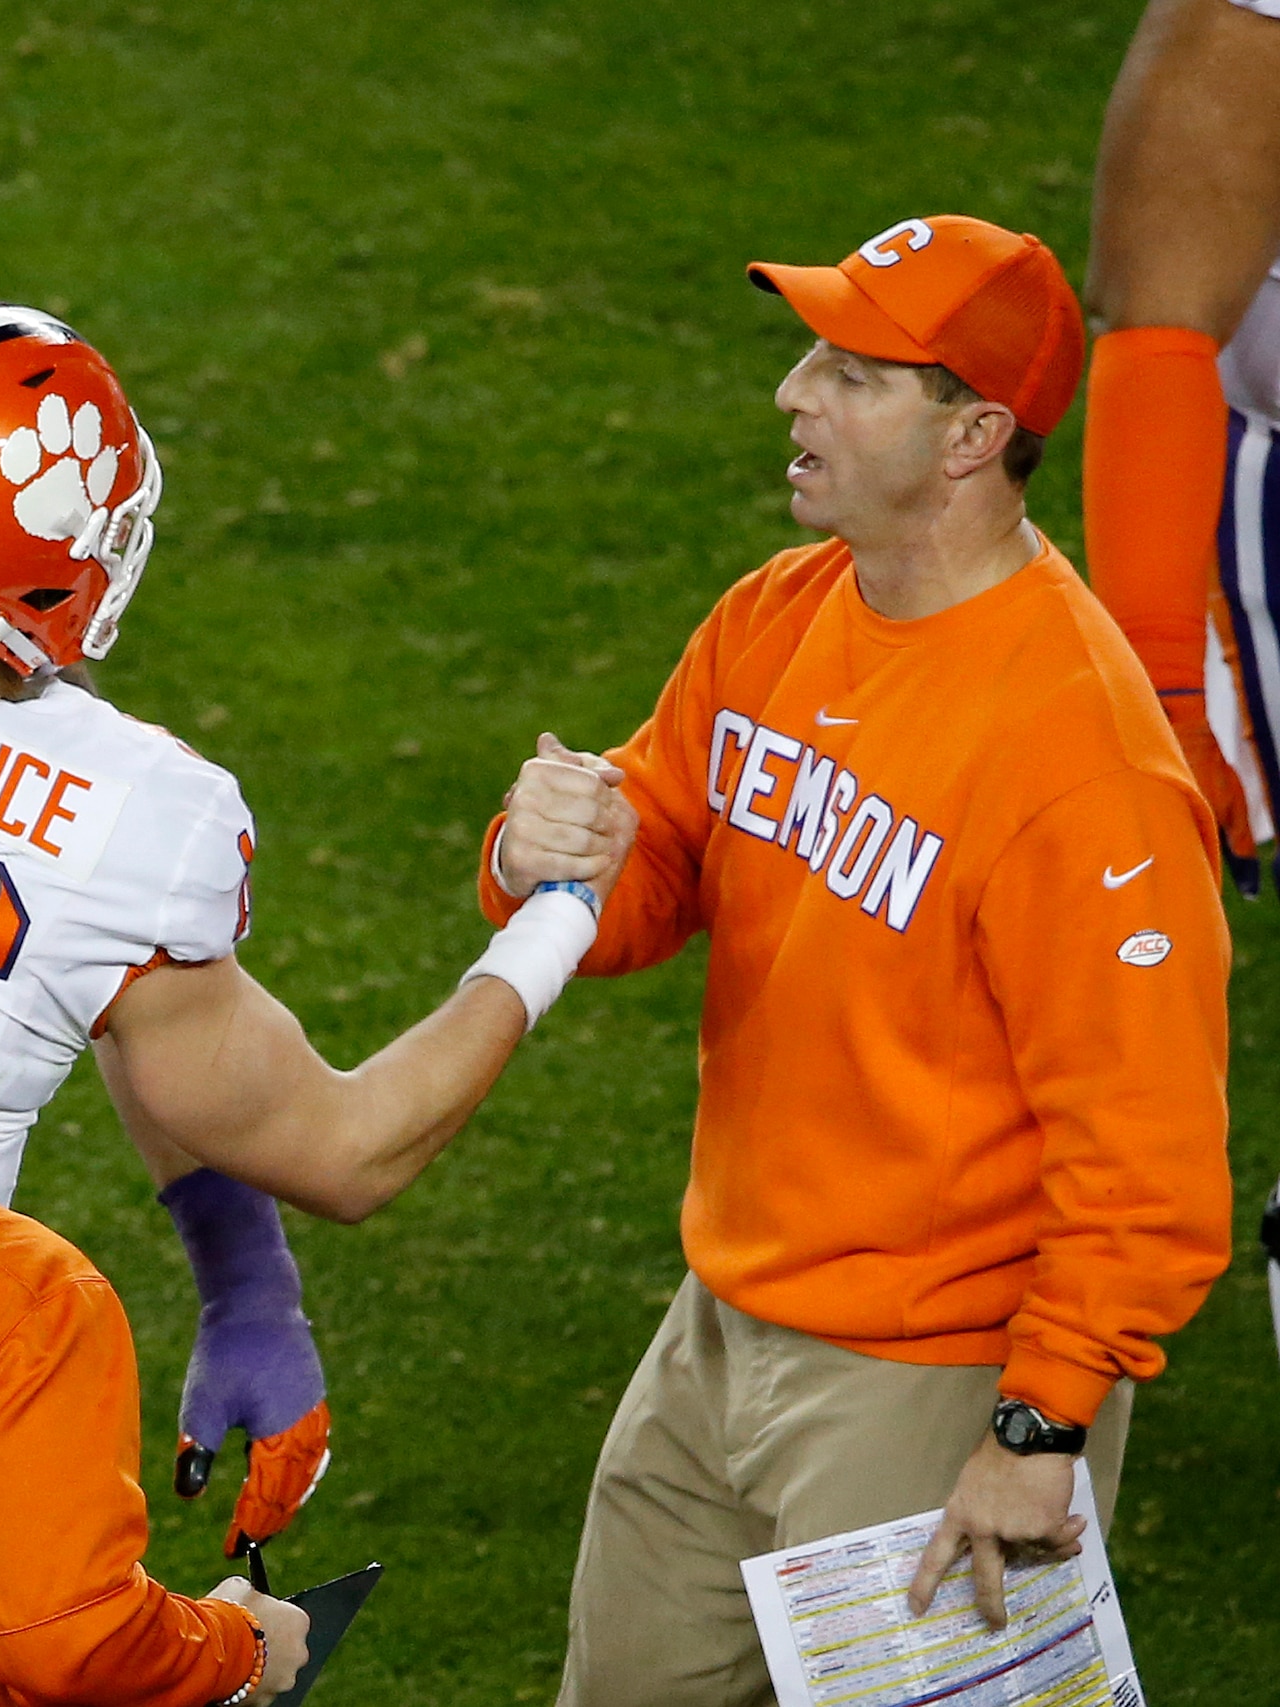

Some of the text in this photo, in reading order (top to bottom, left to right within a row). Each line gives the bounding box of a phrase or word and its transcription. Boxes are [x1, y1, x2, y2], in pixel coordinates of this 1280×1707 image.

[858, 218, 934, 267] C
[708, 707, 944, 934] CEMSON
[1126, 937, 1165, 956] ACC
